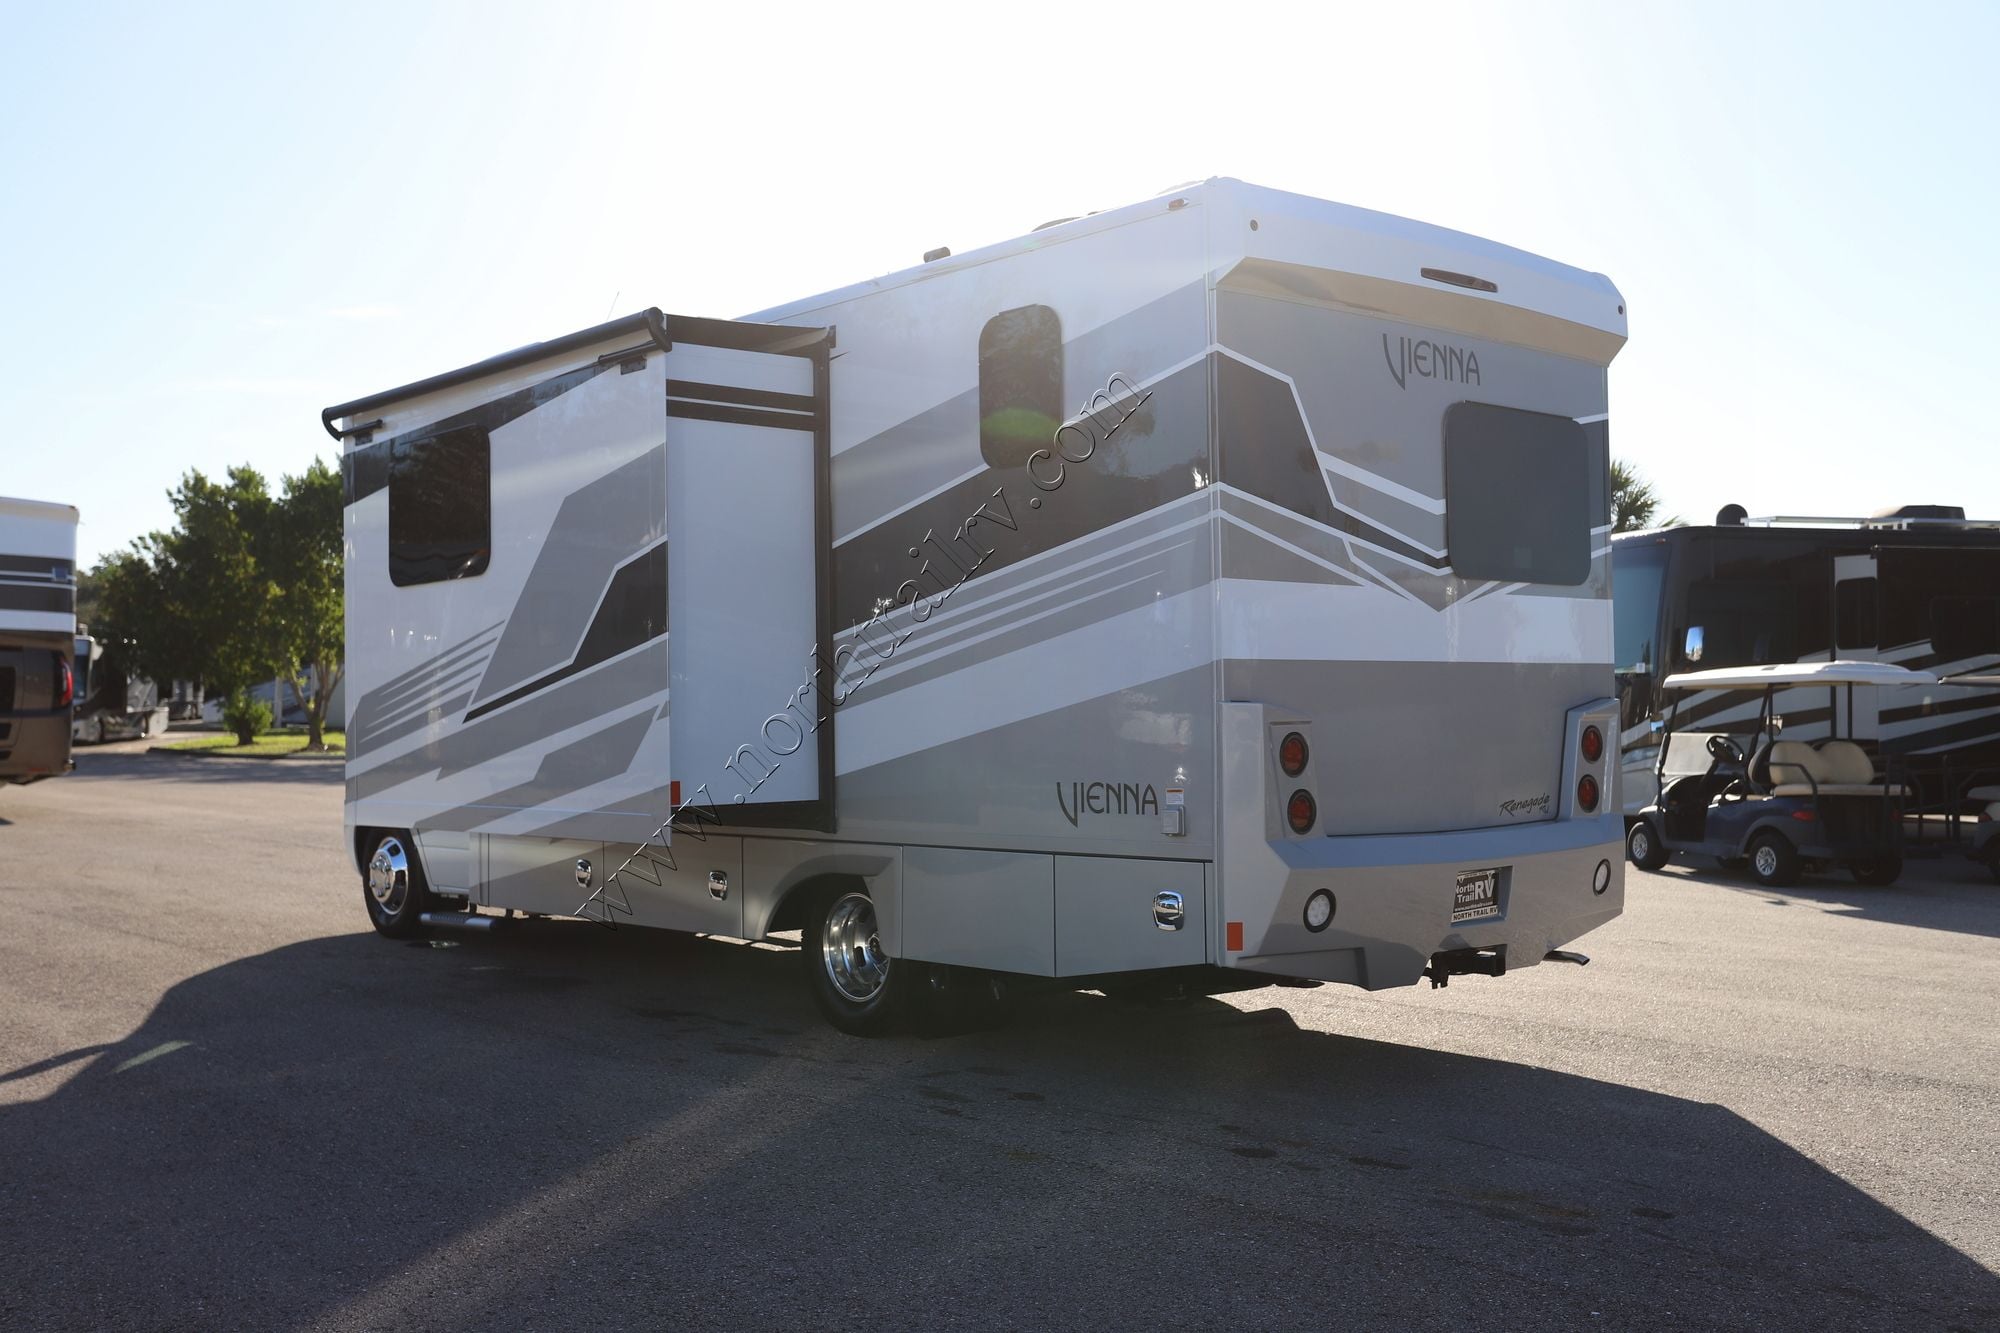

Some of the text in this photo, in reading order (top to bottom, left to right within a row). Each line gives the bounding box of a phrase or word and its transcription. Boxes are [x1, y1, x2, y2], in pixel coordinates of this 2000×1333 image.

[1382, 333, 1481, 391] VIENNA
[1056, 782, 1158, 828] VIENNA
[1499, 792, 1550, 816] Renegade
[1457, 892, 1474, 903] Trail
[1474, 880, 1495, 900] RV
[1453, 911, 1471, 921] NORTH
[1473, 908, 1488, 917] TRAIL
